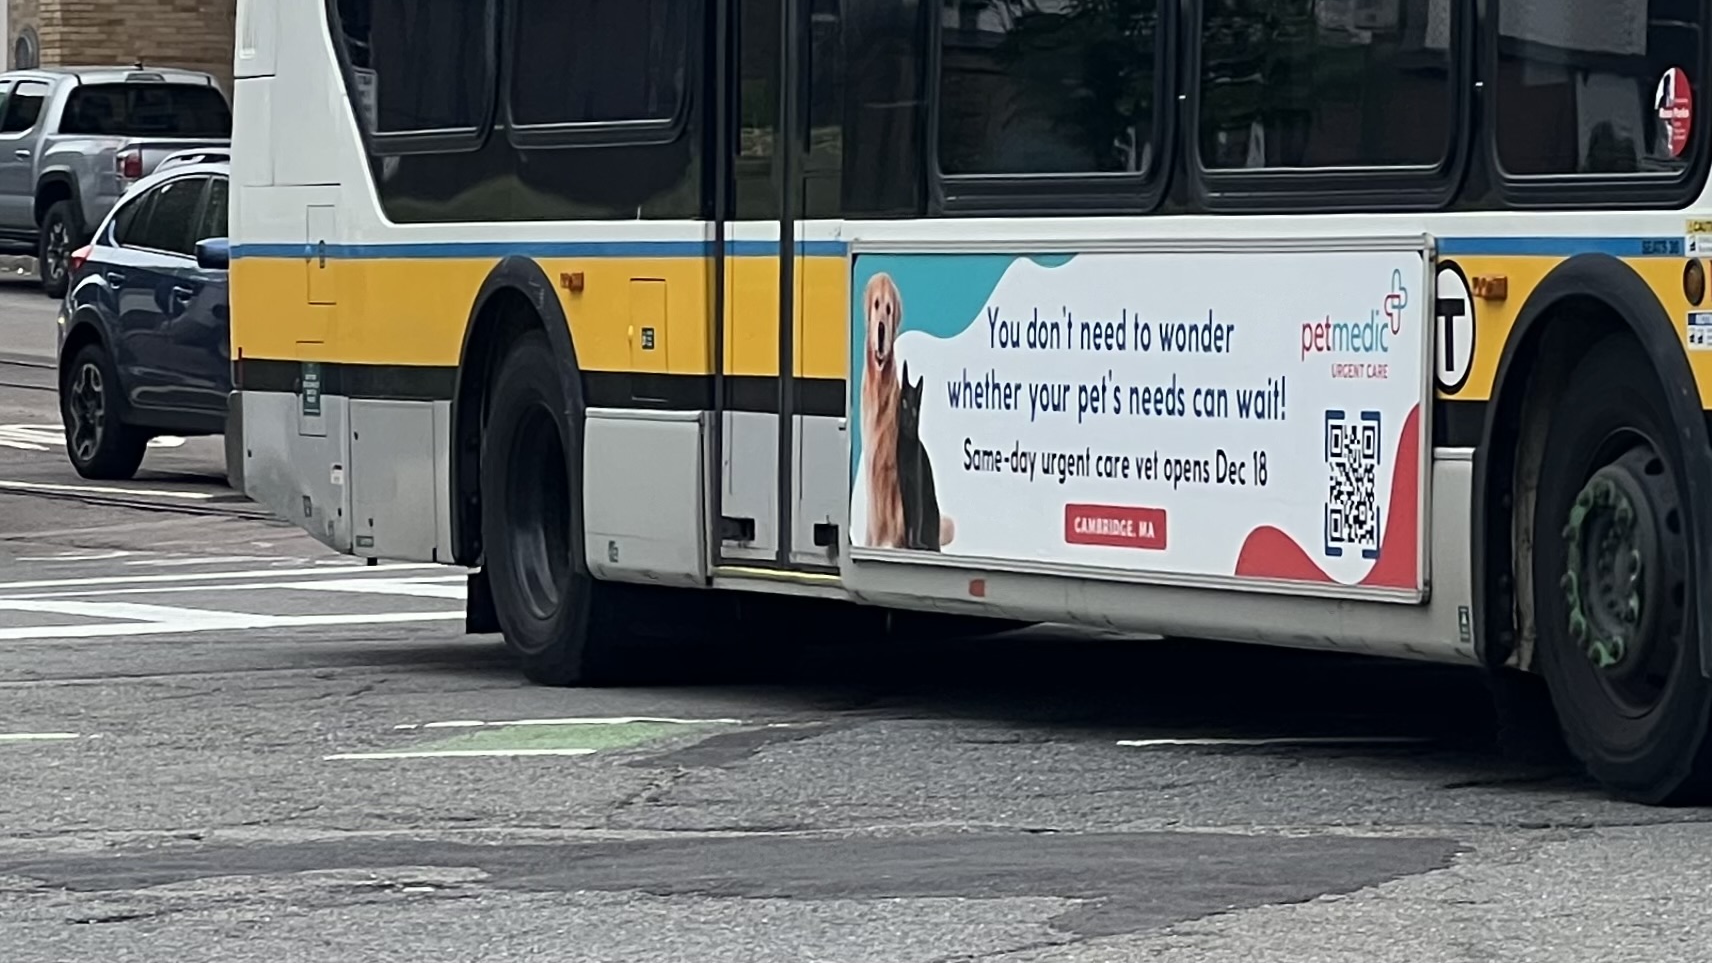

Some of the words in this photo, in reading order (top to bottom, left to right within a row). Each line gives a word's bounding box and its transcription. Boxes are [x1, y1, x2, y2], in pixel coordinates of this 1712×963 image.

[987, 306, 1021, 349] You
[1026, 305, 1073, 350] don't
[1080, 308, 1127, 351] need
[1134, 312, 1152, 352] to
[1159, 308, 1235, 353] wonder
[1302, 309, 1389, 361] petmedic
[947, 368, 1022, 412] whether
[1028, 382, 1071, 423] your
[1077, 369, 1121, 424] pet's
[1129, 373, 1186, 418] needs
[1193, 387, 1229, 419] can
[1236, 375, 1287, 421] wait!
[1331, 363, 1365, 379] URGENT
[1366, 363, 1389, 379] CARE
[963, 437, 1037, 482] Same-day
[1041, 446, 1091, 485] urgent
[1097, 453, 1130, 480] care
[1135, 450, 1159, 481] vet
[1163, 457, 1211, 490] opens
[1215, 448, 1246, 486] Dec
[1252, 450, 1269, 487] 18
[1138, 519, 1155, 539] MA
